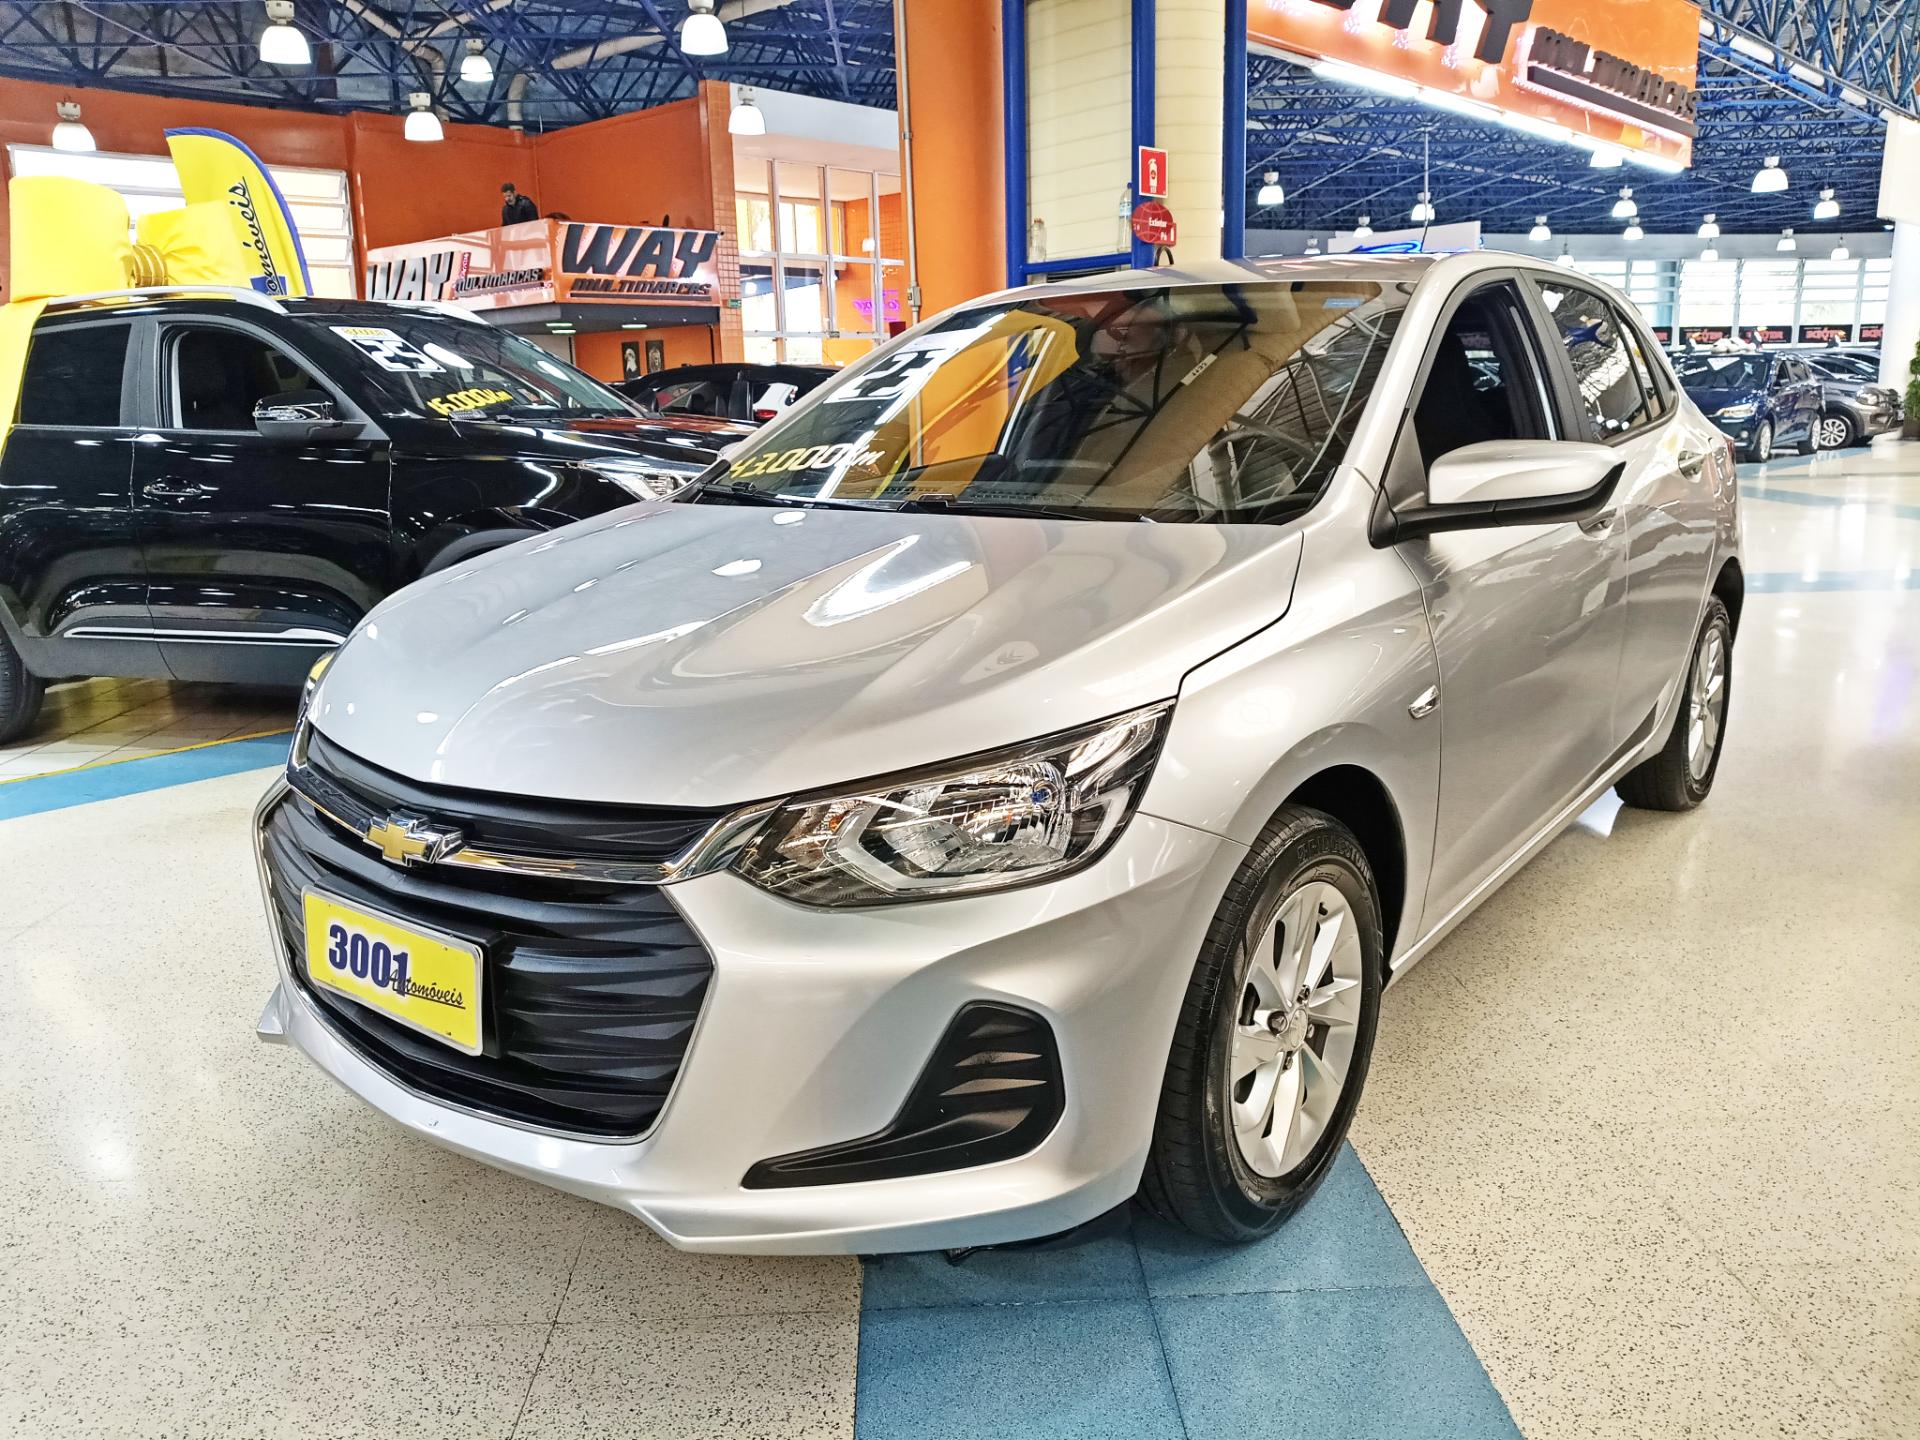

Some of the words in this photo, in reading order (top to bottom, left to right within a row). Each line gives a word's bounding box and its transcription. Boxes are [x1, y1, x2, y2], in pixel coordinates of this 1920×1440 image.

[228, 181, 281, 296] omóveis
[562, 224, 718, 278] WAY
[366, 251, 454, 301] WAY
[571, 278, 712, 295] MULTIMARCAS
[353, 339, 441, 371] 25
[328, 923, 409, 997] 3001
